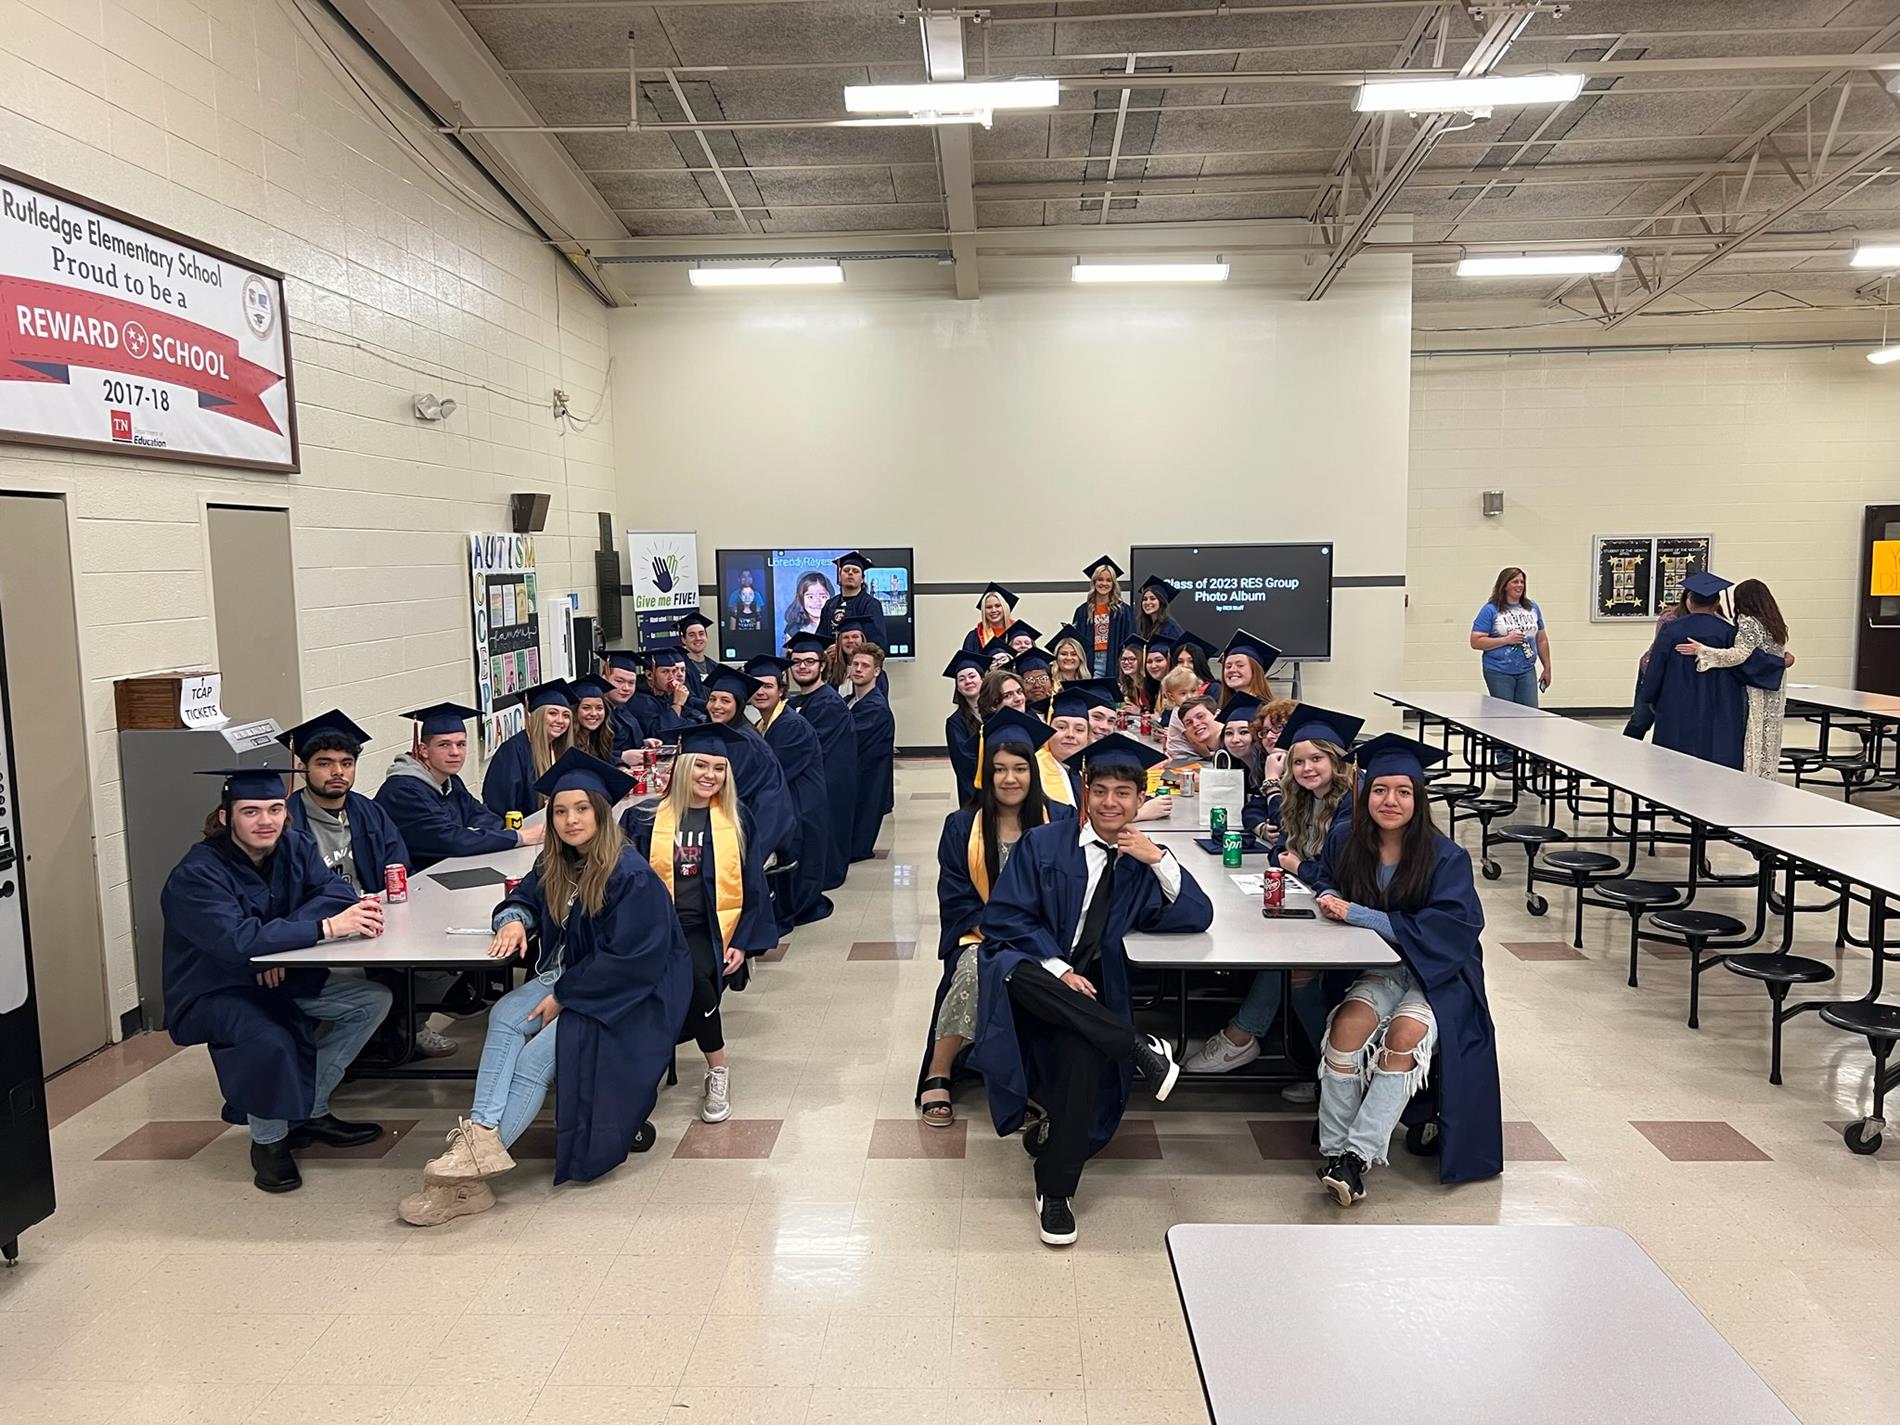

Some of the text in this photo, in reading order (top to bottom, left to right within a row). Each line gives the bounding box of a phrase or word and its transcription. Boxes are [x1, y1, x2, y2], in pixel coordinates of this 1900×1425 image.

[2, 188, 222, 288] Rutledge Elementary School
[51, 246, 187, 309] Proud to be a
[16, 304, 230, 381] REWARD SCHOOL
[102, 379, 170, 412] 2017-18
[113, 418, 129, 432] TN
[133, 435, 167, 448] Education
[474, 534, 536, 570] AUTISM
[1195, 578, 1208, 590] of
[1209, 578, 1238, 590] 2023
[1240, 577, 1263, 589] RES
[1265, 577, 1300, 590] Group
[636, 591, 697, 608] Give me FIVE!
[1194, 590, 1266, 602] Photo Album
[192, 686, 213, 700] TCAP
[184, 704, 218, 721] TICKETS
